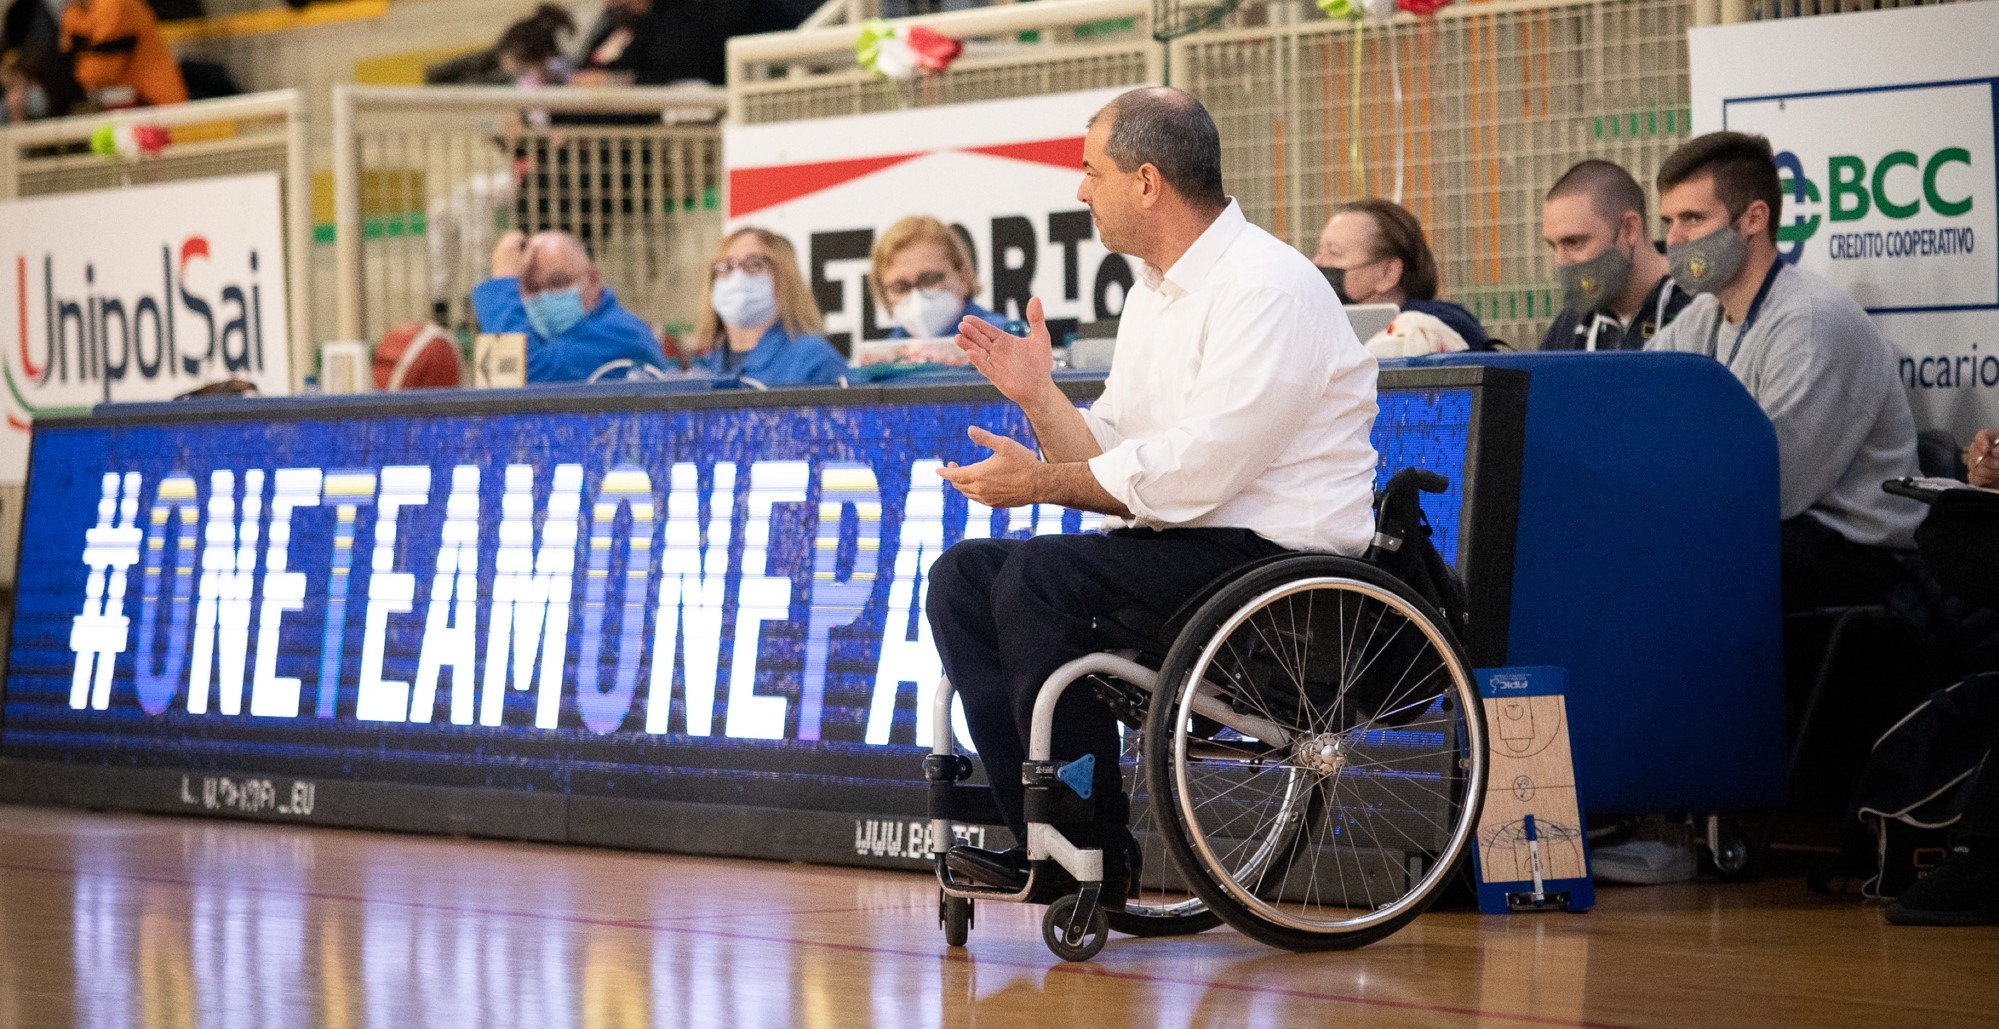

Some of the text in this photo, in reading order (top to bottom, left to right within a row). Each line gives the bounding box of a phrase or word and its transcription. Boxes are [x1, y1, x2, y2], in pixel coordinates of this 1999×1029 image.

[1828, 147, 1974, 223] BCC
[1829, 227, 1974, 260] CREDITO COOPERATIVO
[17, 235, 265, 402] UnipolSai
[1899, 342, 1999, 389] ncario
